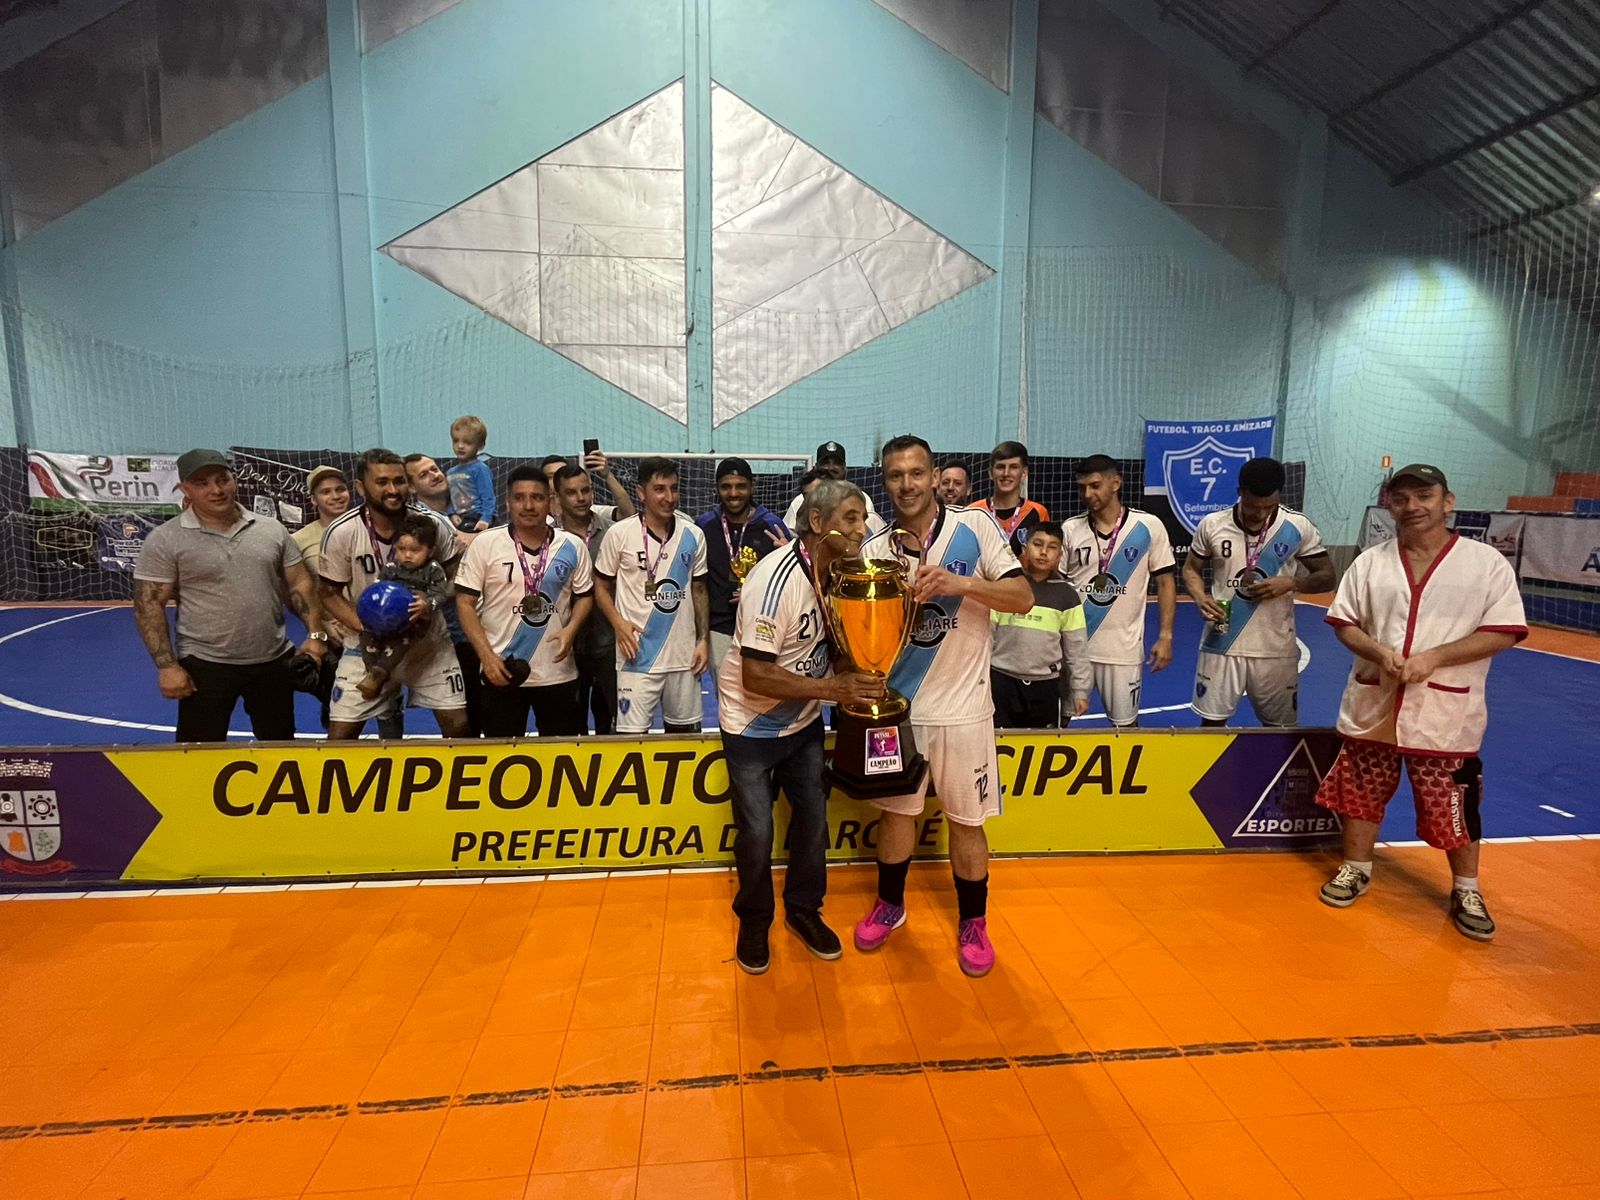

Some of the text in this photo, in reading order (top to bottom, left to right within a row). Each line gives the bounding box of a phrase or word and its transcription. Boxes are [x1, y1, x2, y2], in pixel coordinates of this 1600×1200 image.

[1192, 424, 1223, 434] TRAGO
[1225, 424, 1231, 432] E
[1190, 457, 1227, 475] E.C.
[89, 475, 159, 497] Perin
[1200, 477, 1217, 502] 7
[1075, 546, 1091, 567] 17
[1221, 540, 1232, 558] 8
[356, 553, 376, 574] 10
[636, 551, 647, 571] 5
[502, 561, 514, 585] 7
[799, 608, 818, 640] 21
[446, 674, 464, 694] 10
[213, 750, 735, 817] CAMPEONATO
[974, 773, 988, 803] 12
[1247, 818, 1334, 833] ESPORTES
[451, 825, 704, 862] PREFEITURA
